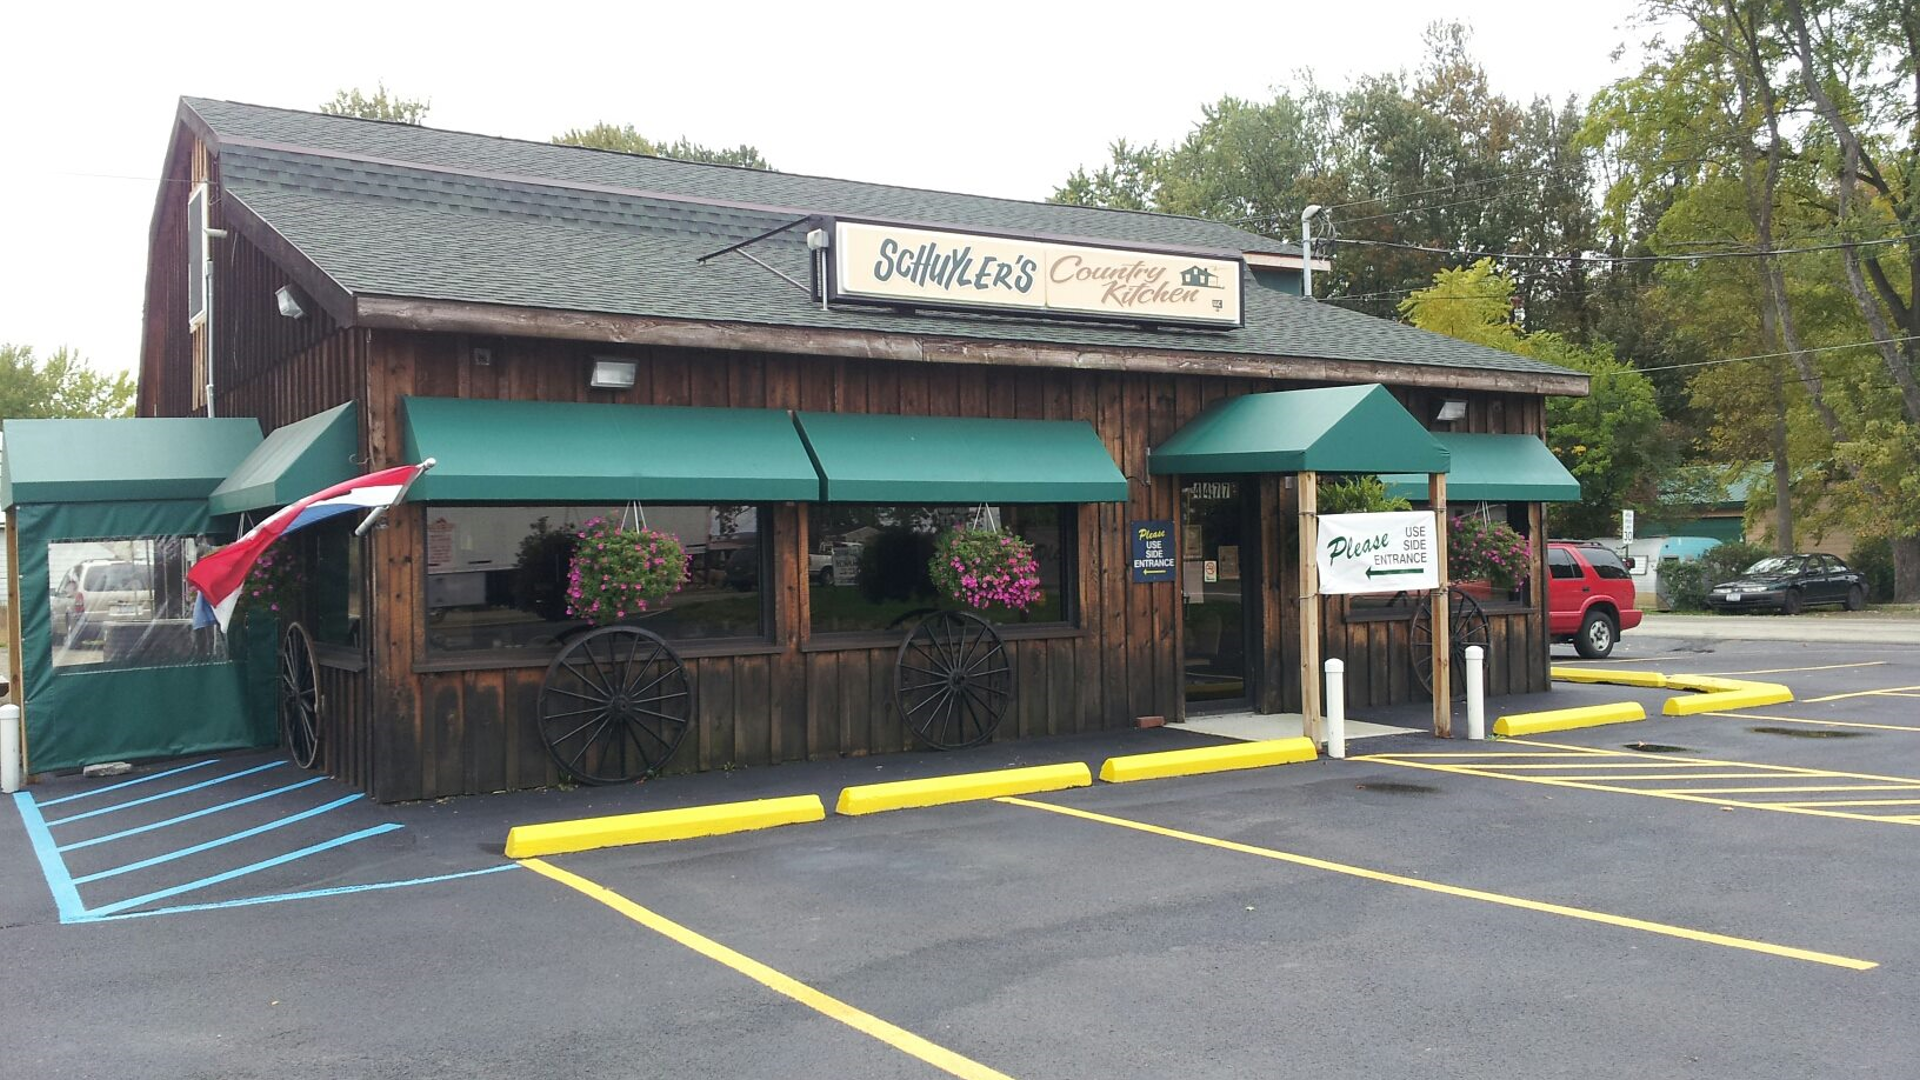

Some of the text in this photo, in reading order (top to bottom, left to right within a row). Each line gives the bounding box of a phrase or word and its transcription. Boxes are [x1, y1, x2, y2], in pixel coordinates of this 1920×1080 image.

[874, 238, 1037, 293] SCHUYLER'S
[1050, 255, 1167, 283] Country
[1101, 280, 1199, 307] Kitchen
[1193, 482, 1230, 498] 4477
[1138, 528, 1166, 540] Please
[1405, 526, 1426, 538] USE
[1146, 541, 1162, 549] USE
[1327, 533, 1389, 566] Please
[1403, 539, 1427, 551] SIDE
[1145, 550, 1163, 558] SIDE
[1374, 552, 1428, 565] ENTRANCE
[1133, 558, 1175, 568] ENTRANCE
